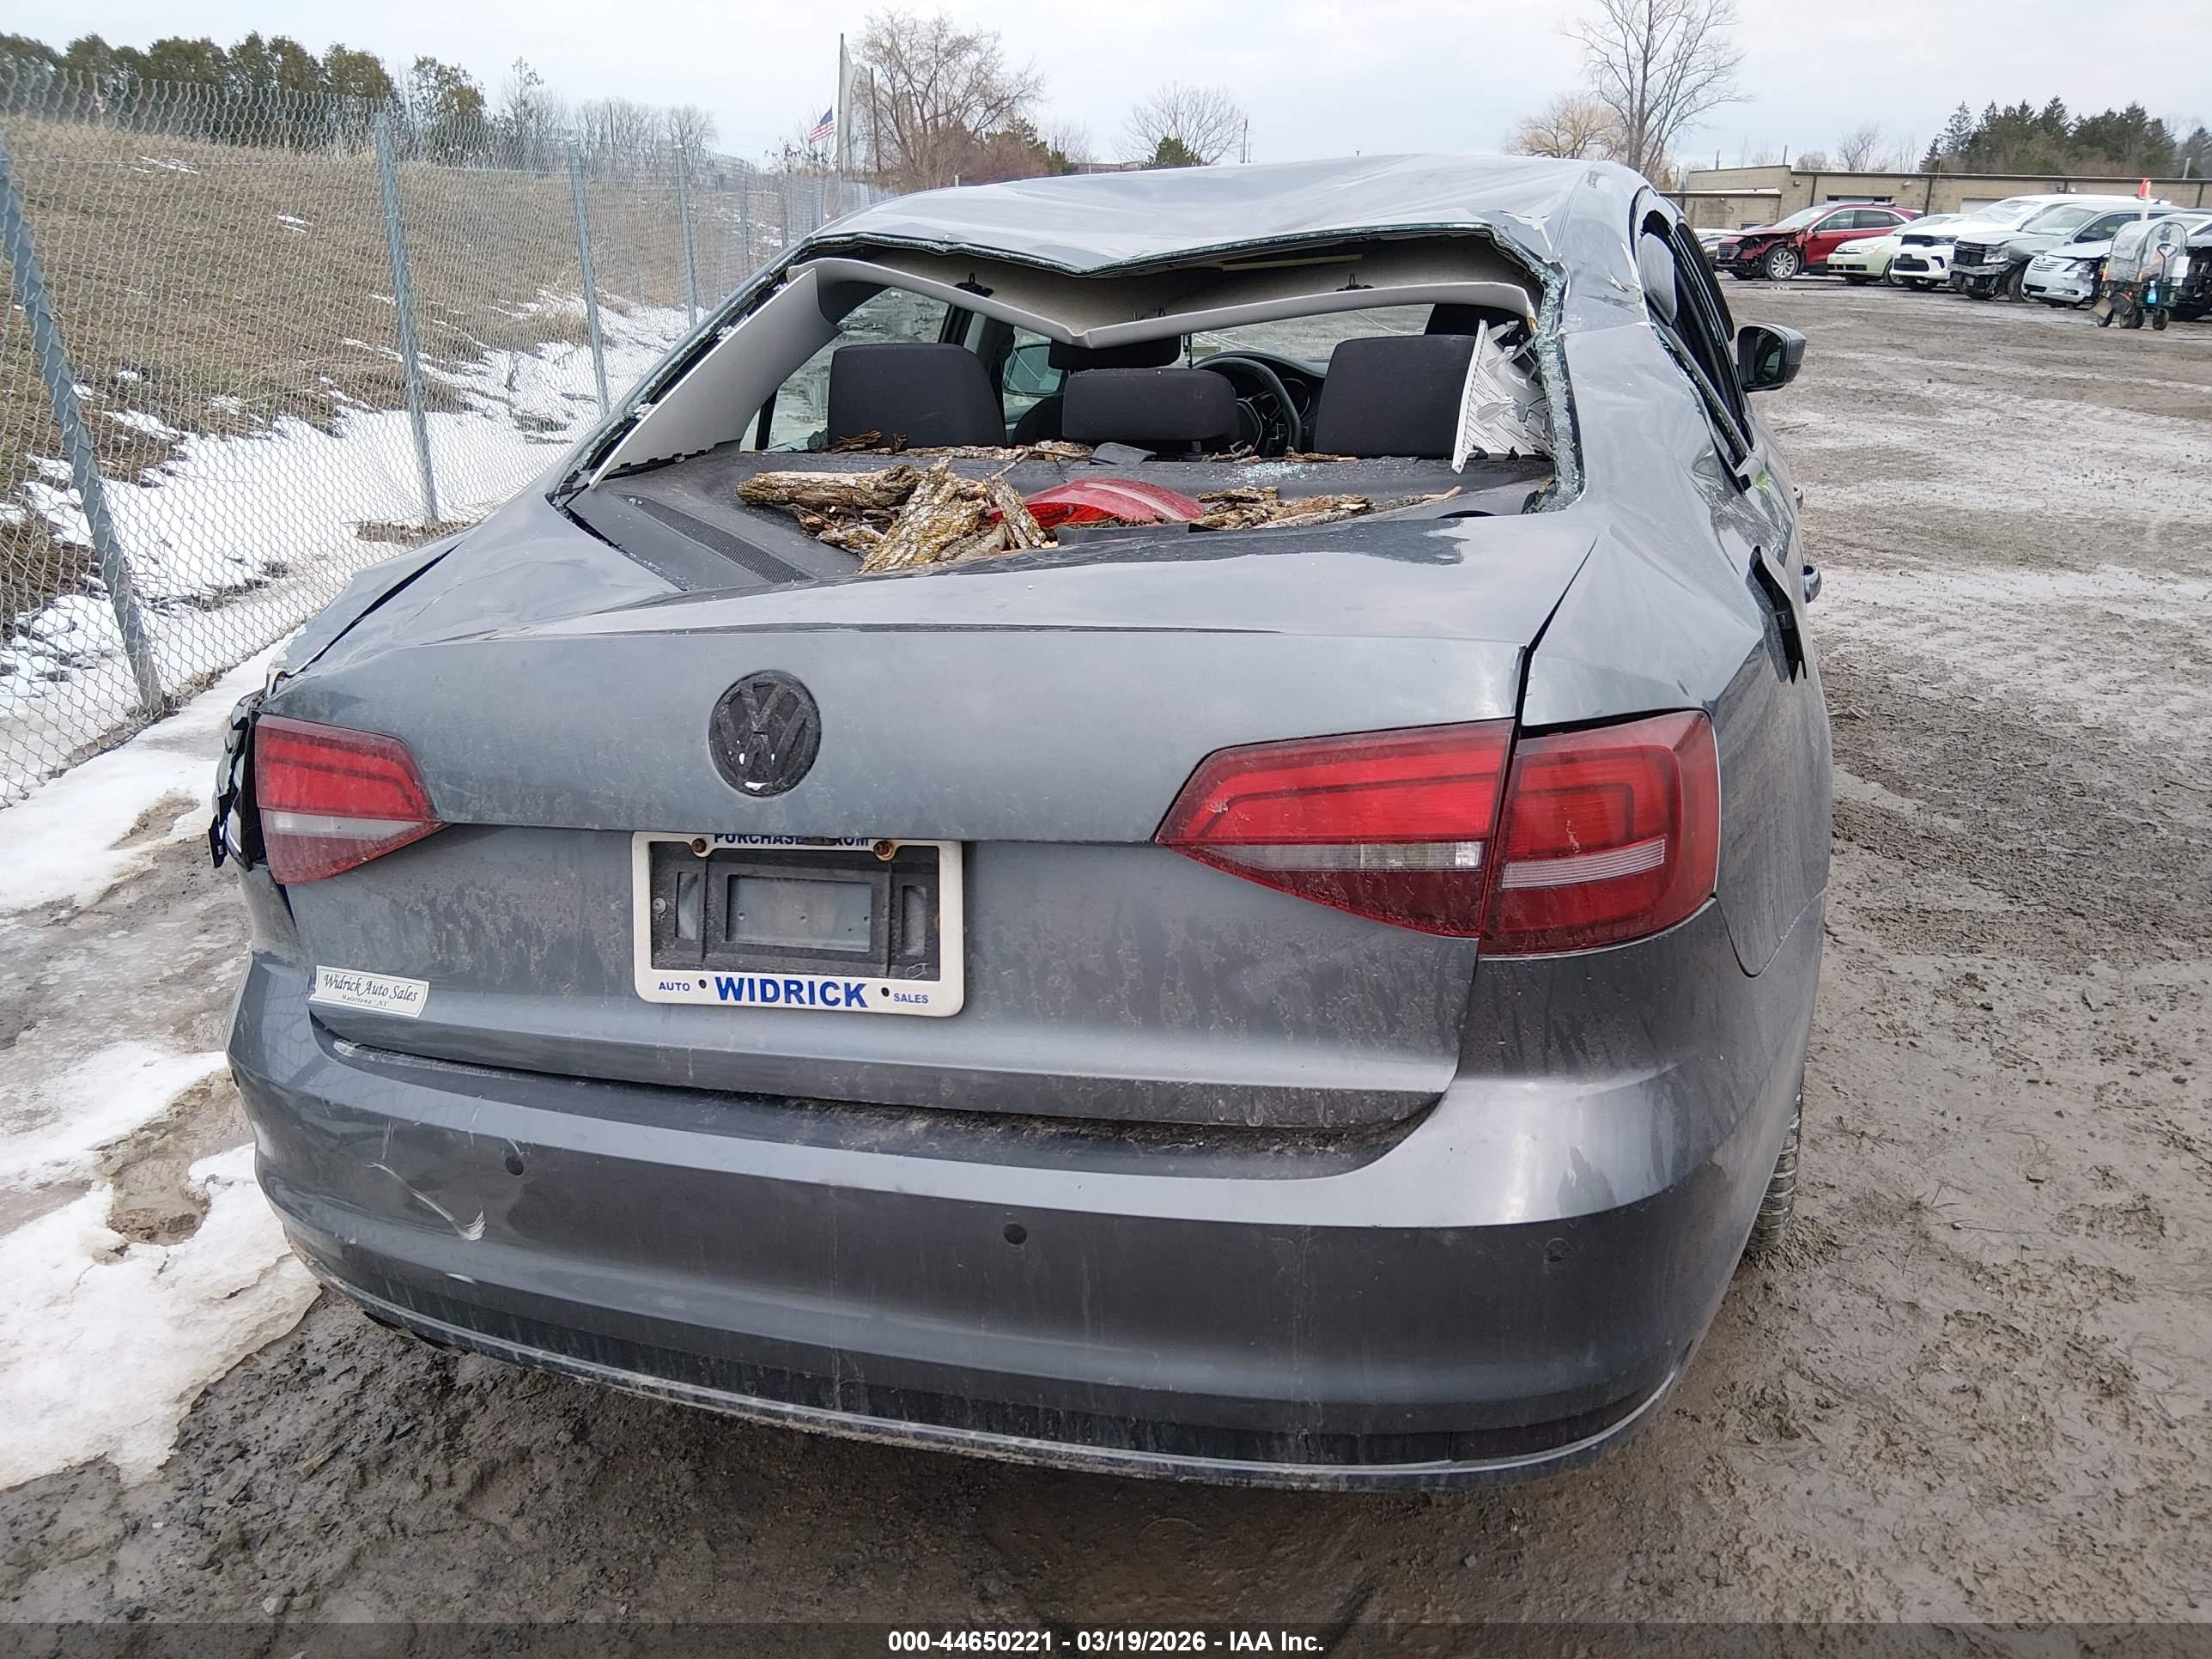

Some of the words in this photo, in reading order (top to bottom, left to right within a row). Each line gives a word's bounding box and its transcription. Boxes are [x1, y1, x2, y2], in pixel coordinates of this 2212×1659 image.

[324, 973, 362, 996] Widrick
[362, 980, 389, 997] Auto
[389, 985, 418, 1002] Sales
[658, 981, 690, 992] AUTO
[714, 975, 869, 1008] WIDRICK
[893, 992, 929, 1004] SALES
